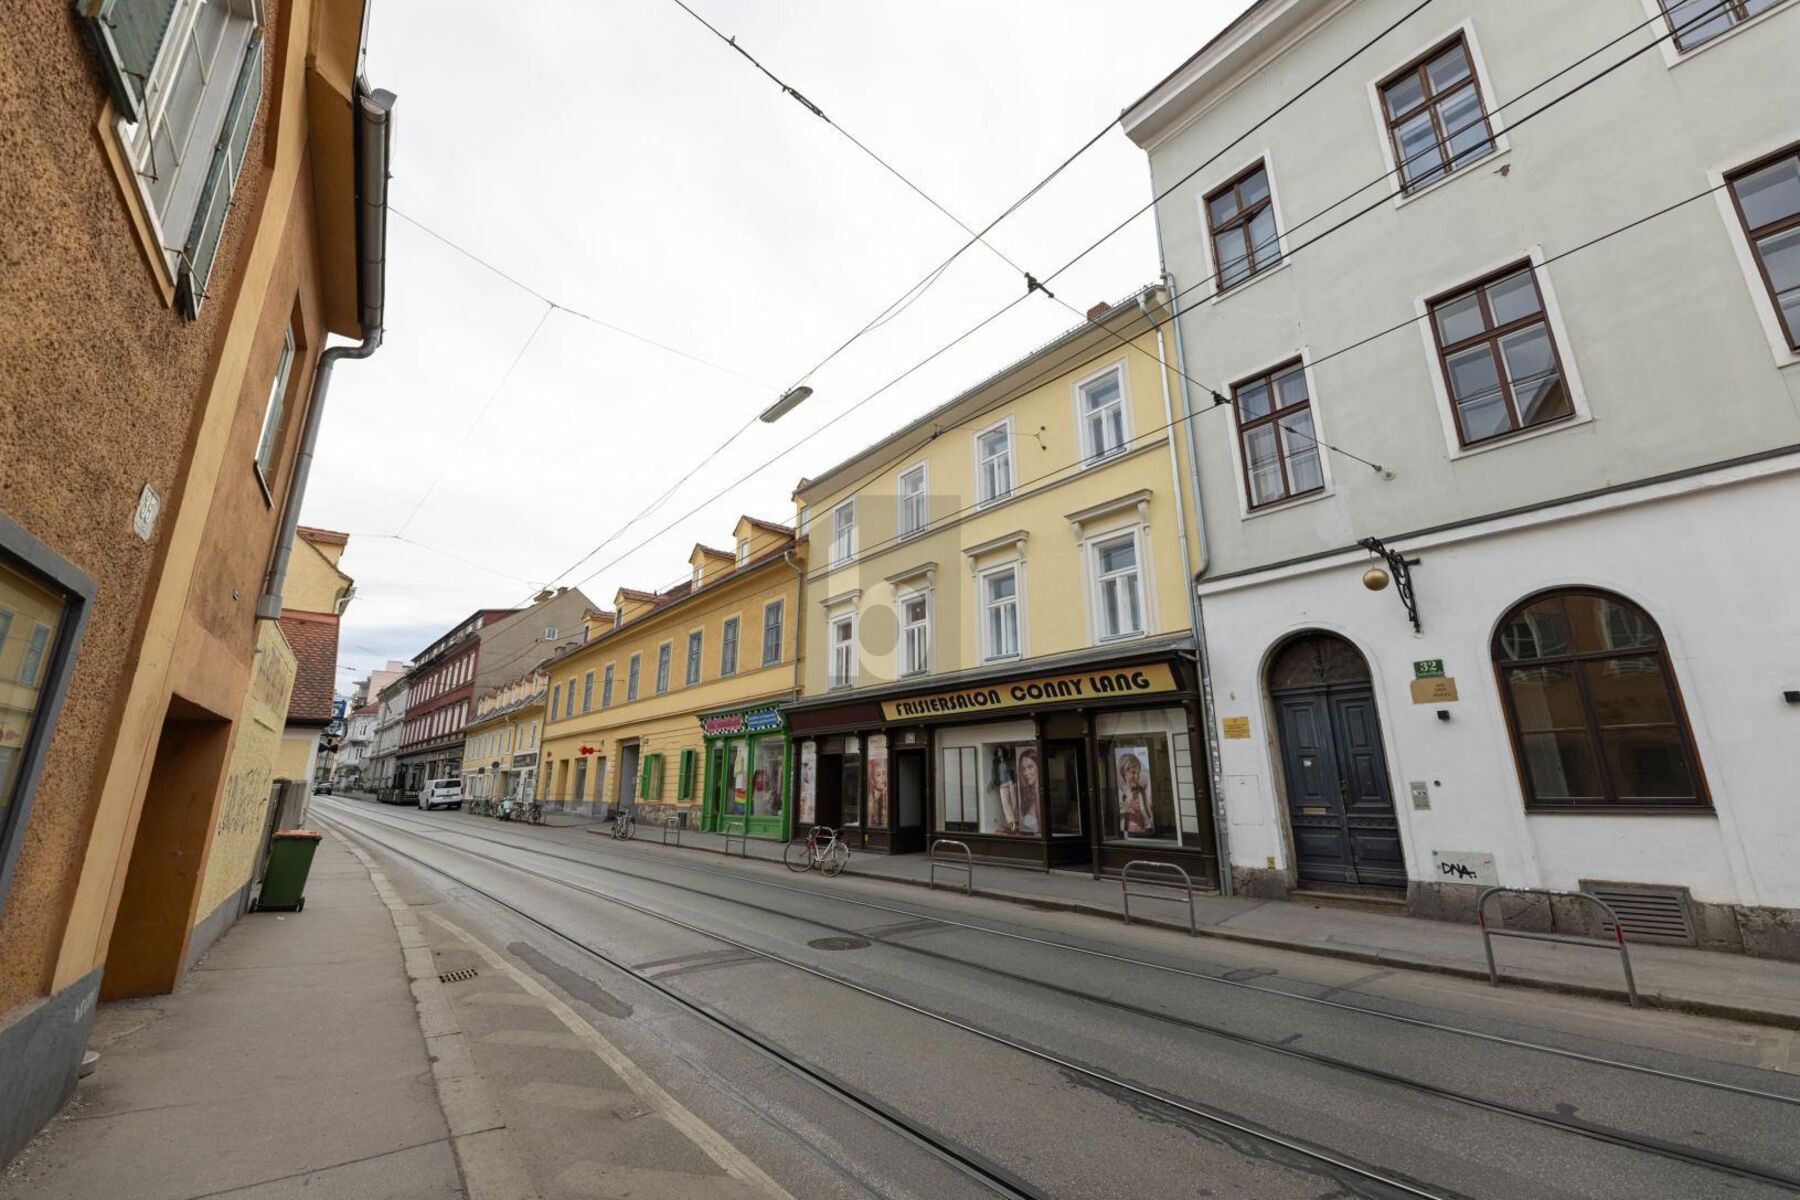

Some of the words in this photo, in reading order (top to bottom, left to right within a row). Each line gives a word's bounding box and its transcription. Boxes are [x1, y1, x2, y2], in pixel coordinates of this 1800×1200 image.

[1420, 660, 1437, 672] 32
[896, 689, 1001, 716] FRISIERSALON
[1011, 679, 1083, 702] CONNY
[1090, 672, 1150, 693] LANG
